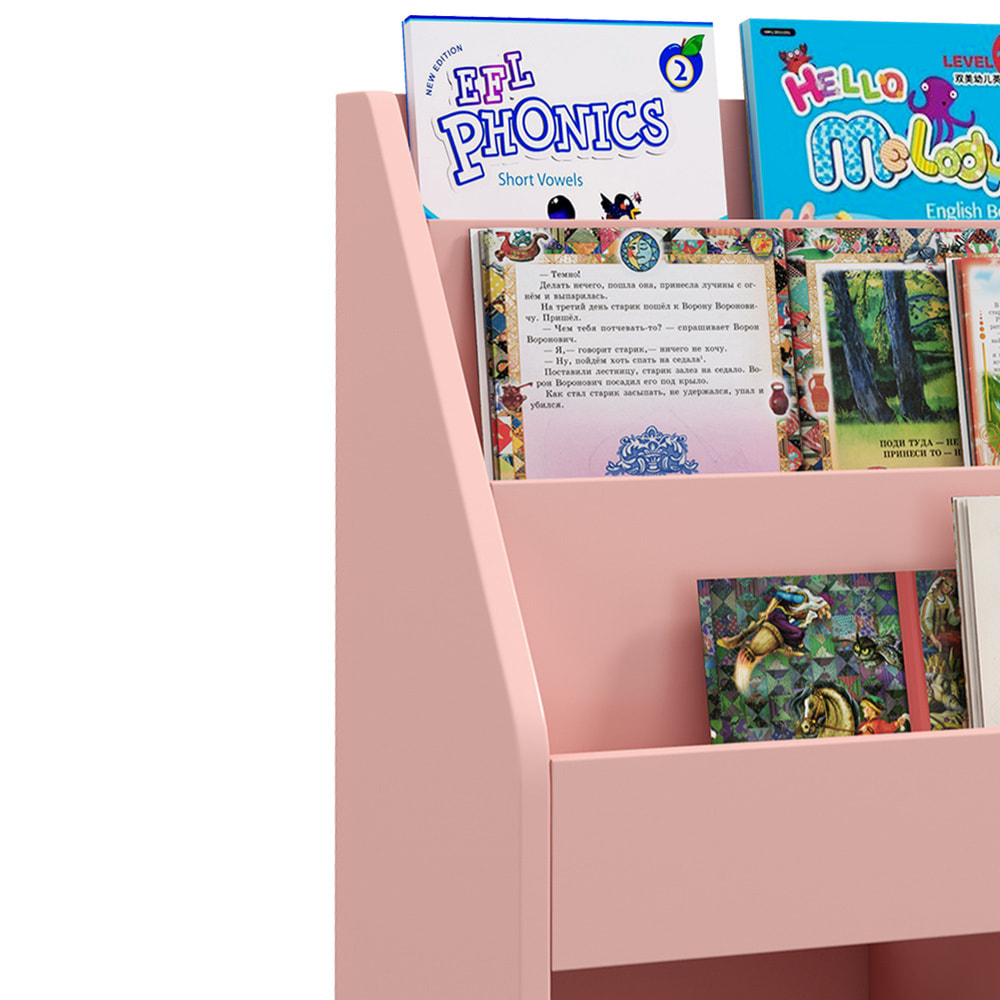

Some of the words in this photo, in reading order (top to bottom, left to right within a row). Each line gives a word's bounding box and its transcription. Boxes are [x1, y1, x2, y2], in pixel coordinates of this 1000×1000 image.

[943, 55, 992, 68] LEVEL
[425, 72, 436, 96] NEW
[434, 44, 464, 72] EDITION
[674, 59, 688, 81] 2
[453, 50, 535, 107] EFL
[784, 65, 905, 112] HELLO
[437, 96, 670, 186] PHONICS
[498, 172, 534, 186] Short
[536, 172, 584, 187] Vowels
[926, 202, 982, 220] English
[551, 270, 581, 278] Темно!
[539, 281, 571, 290] Делать
[659, 282, 700, 290] принесла
[553, 293, 608, 301] выпарилась.
[556, 303, 586, 312] третий
[682, 302, 712, 311] Ворону
[715, 302, 758, 311] Воронови-
[525, 315, 540, 323] чу.
[542, 313, 582, 323] Пришёл.
[554, 324, 573, 332] Чем
[576, 324, 597, 332] тебя
[600, 323, 662, 331] потчевать-то?
[677, 324, 730, 332] спрашивает
[733, 323, 760, 332] Ворон
[526, 335, 577, 344] Воронович.
[577, 347, 612, 355] говорит
[555, 357, 572, 366] Ну,
[574, 356, 607, 364] пойдём
[544, 368, 592, 376] Поставили
[748, 365, 763, 373] Во-
[555, 379, 603, 387] Воронович
[678, 378, 709, 386] крыло.
[545, 389, 564, 398] Как
[589, 390, 620, 398] старик
[528, 401, 565, 410] убился.
[879, 439, 906, 448] ПОДИ
[908, 439, 933, 447] ТУДА
[883, 449, 927, 458] ПРИНЕСИ
